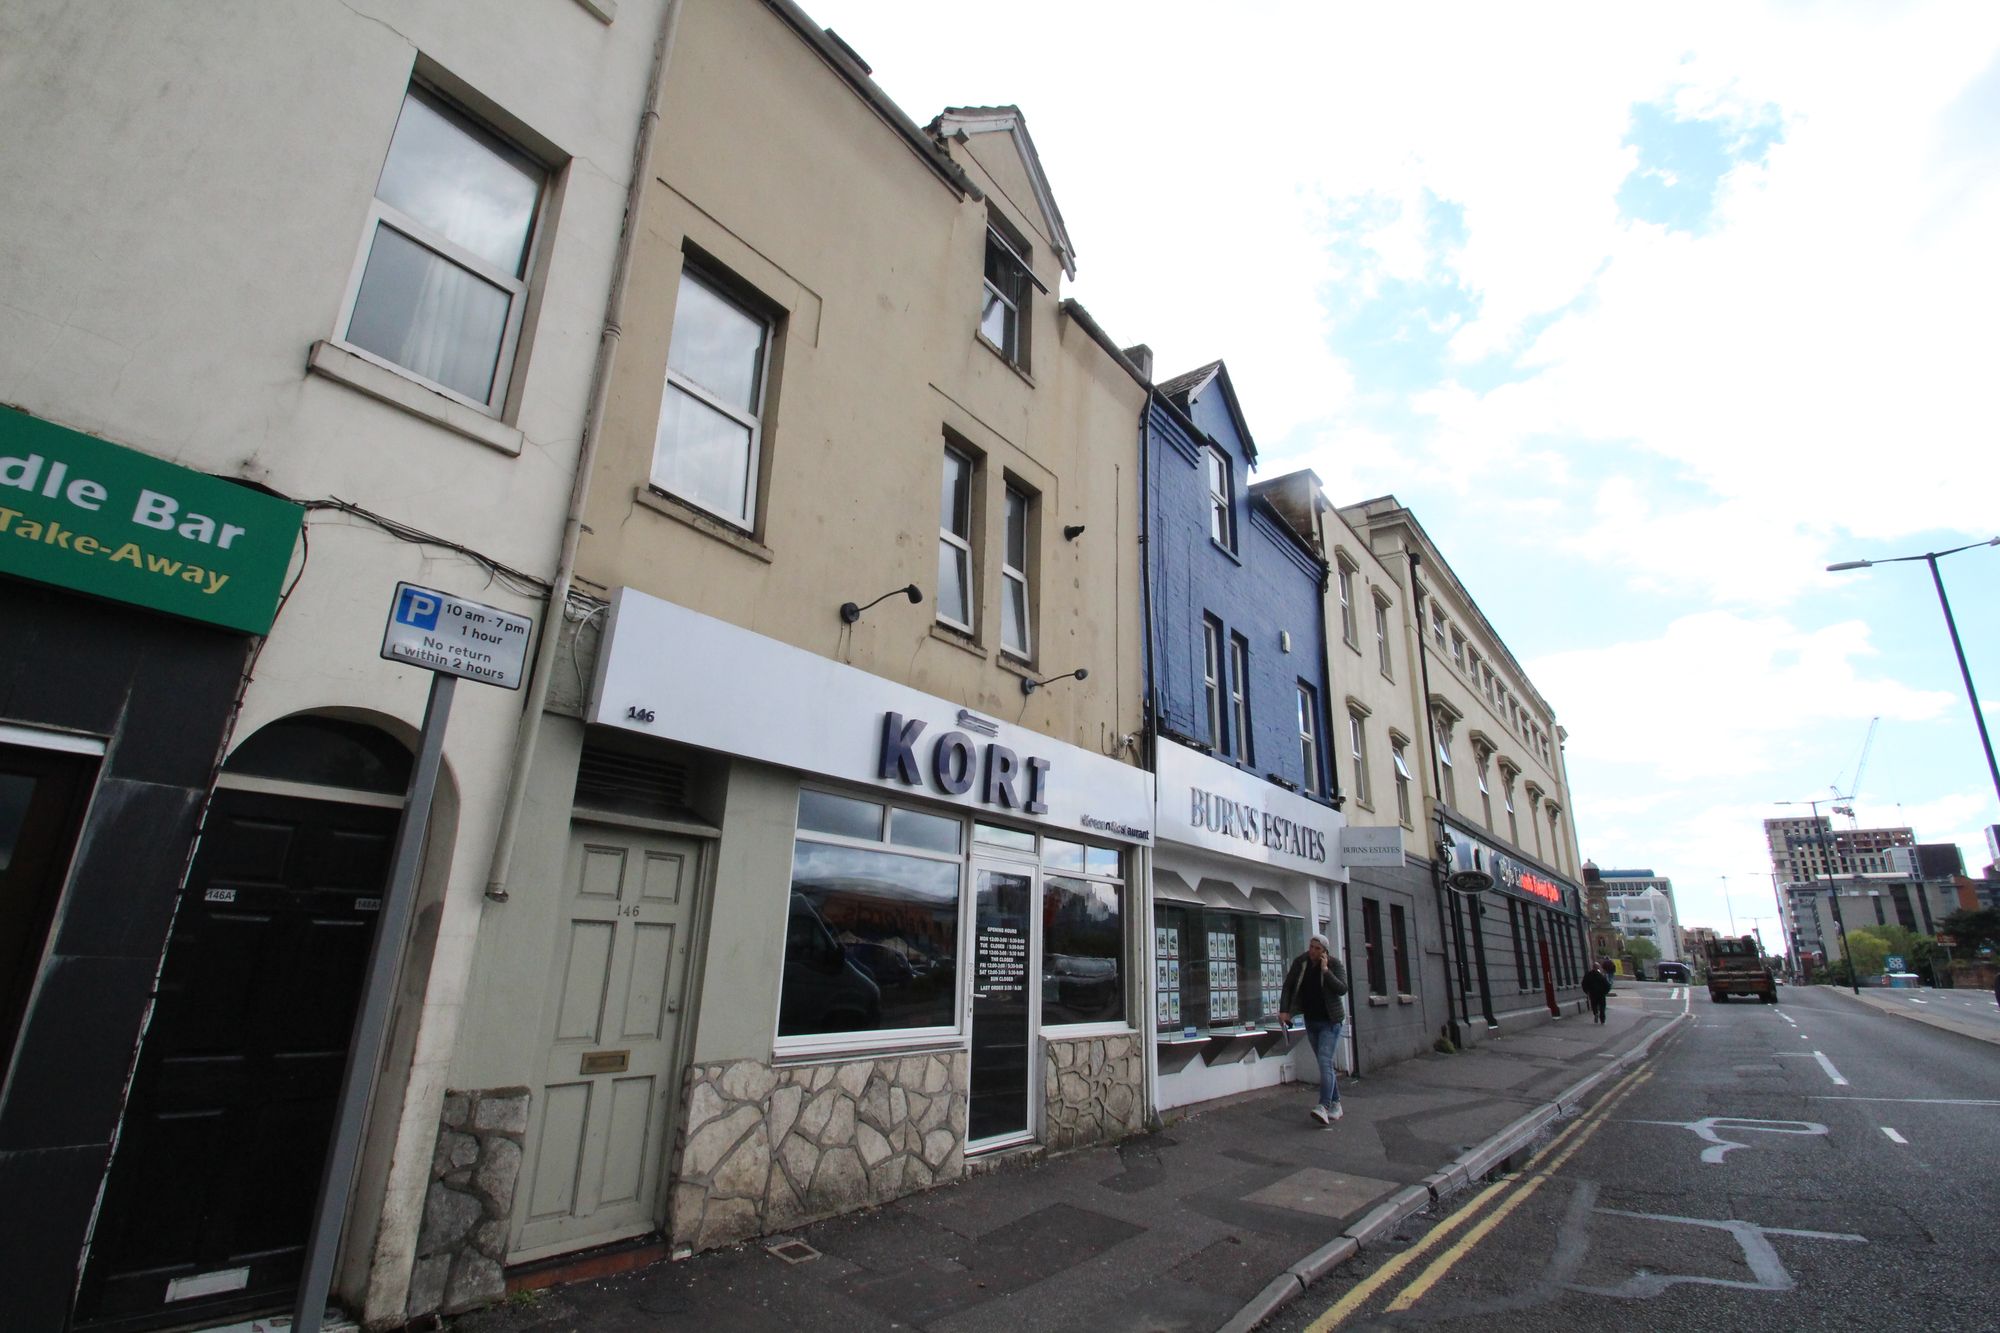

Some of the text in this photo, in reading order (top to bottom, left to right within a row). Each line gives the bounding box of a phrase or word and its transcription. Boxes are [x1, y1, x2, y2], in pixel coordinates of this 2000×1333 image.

[0, 454, 246, 550] dle Bar
[0, 507, 230, 594] Take-Away
[406, 594, 436, 622] P
[446, 604, 462, 617] 10
[465, 610, 484, 624] am
[496, 618, 504, 628] 7
[504, 622, 525, 635] pm
[424, 636, 492, 663] No return
[461, 625, 503, 645] 1 hour
[404, 646, 504, 680] within 2 hours
[628, 706, 655, 722] 146
[878, 711, 1051, 814] KORI
[1190, 786, 1326, 864] BURNS ESTATES
[208, 890, 232, 900] 146A
[618, 904, 640, 917] 146
